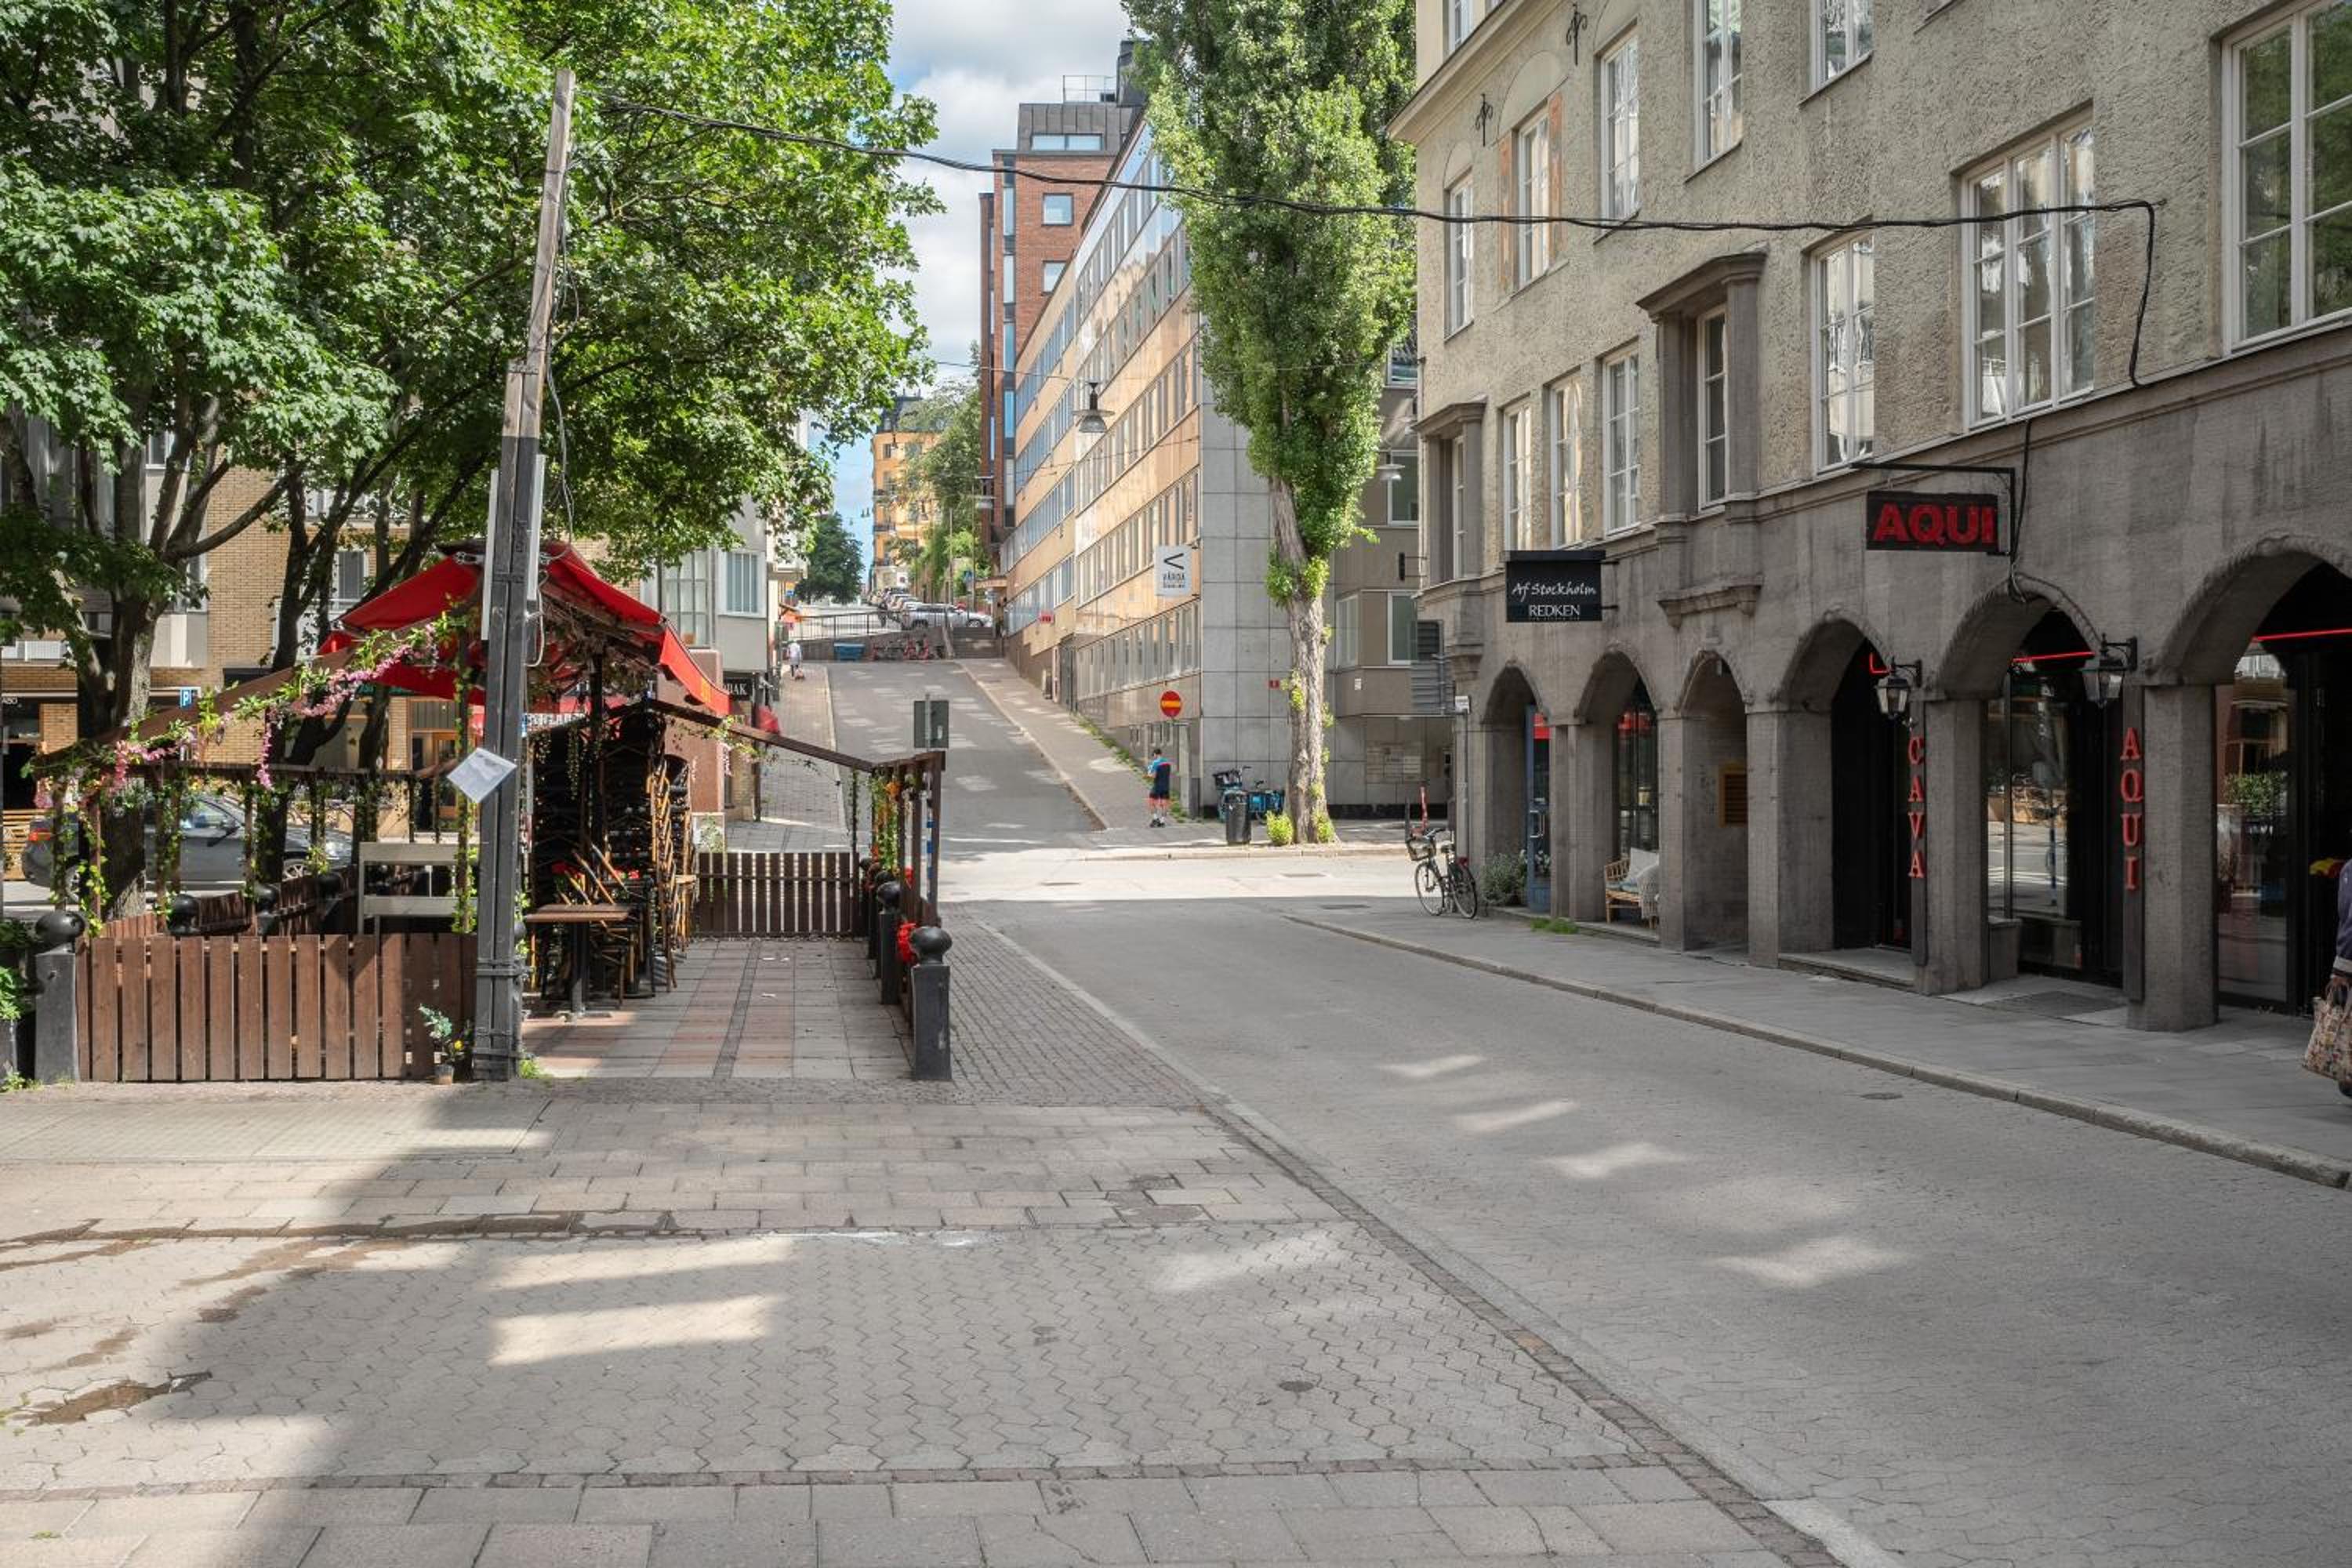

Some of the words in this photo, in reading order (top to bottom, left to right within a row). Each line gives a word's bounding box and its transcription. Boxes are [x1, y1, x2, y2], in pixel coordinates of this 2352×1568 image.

[1873, 501, 1994, 546] AQUI
[1511, 582, 1531, 603] Af
[1531, 581, 1597, 596] Stockholm
[1528, 604, 1581, 616] REDKEN
[1907, 735, 1925, 878] CAVA
[2120, 727, 2143, 890] AQUI
